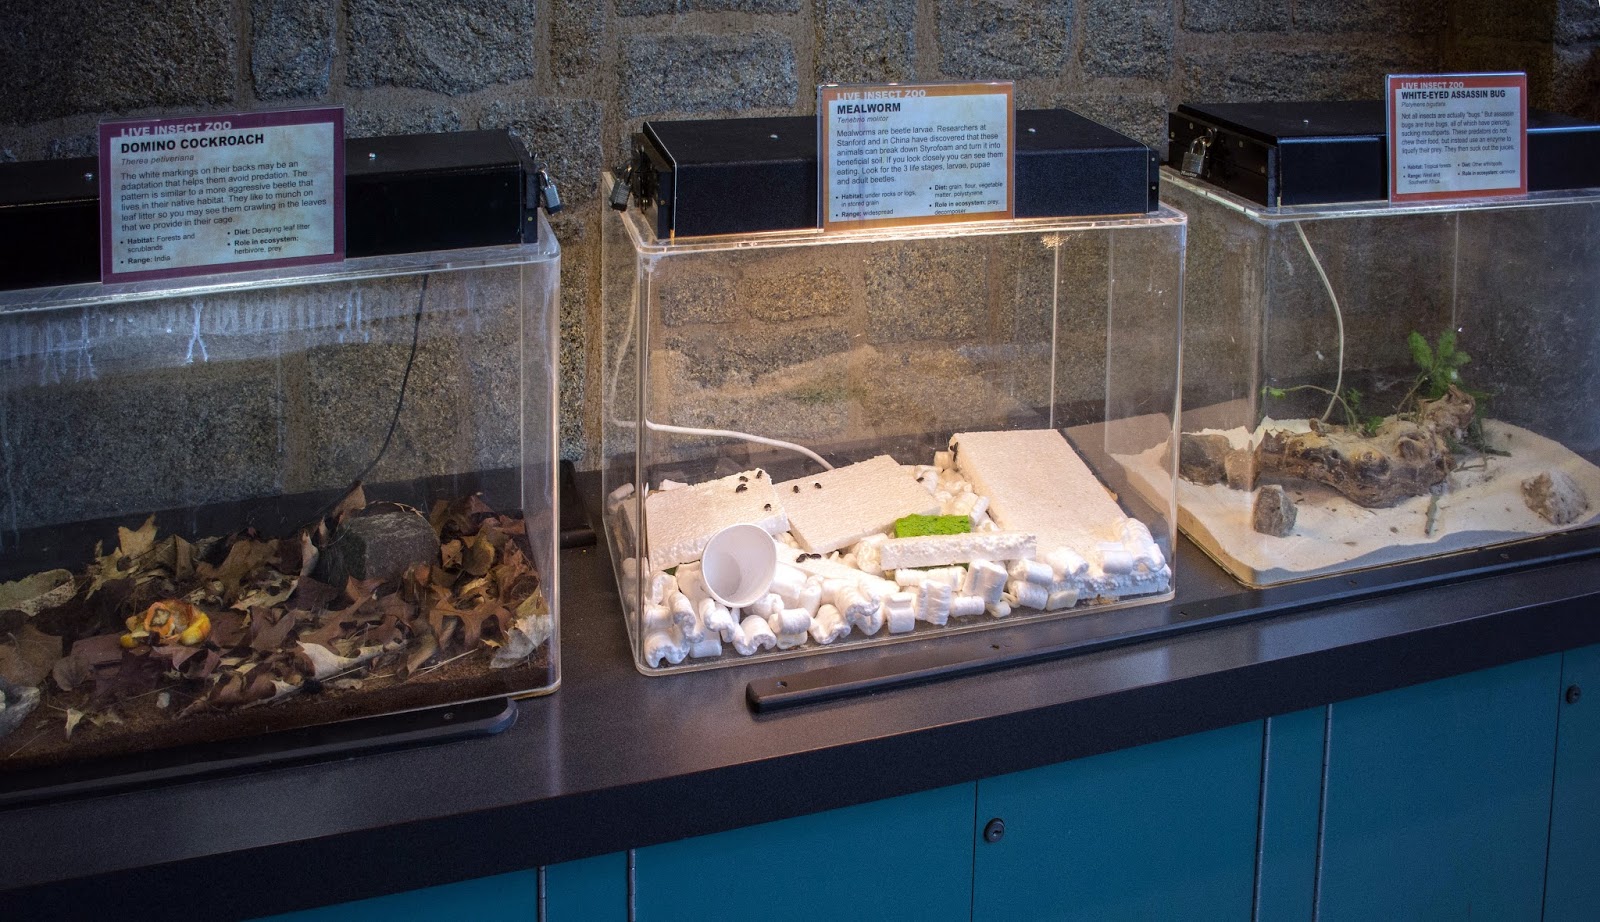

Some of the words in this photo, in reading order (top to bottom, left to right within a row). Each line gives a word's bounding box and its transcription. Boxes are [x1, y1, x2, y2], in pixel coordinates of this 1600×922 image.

[864, 91, 902, 99] INSECT
[1402, 91, 1449, 99] WHITE-EYED
[1452, 90, 1488, 98] ASSASSIN
[837, 103, 900, 114] MEALWORM
[121, 128, 150, 137] LIVE
[155, 124, 202, 135] INSECT
[205, 122, 231, 131] ZOO
[121, 140, 176, 153] DOMINO
[181, 134, 264, 149] COCKROACH
[920, 145, 954, 153] Styrofoam
[162, 169, 199, 177] markings
[232, 164, 256, 172] backs
[121, 181, 163, 191] adaptation
[165, 179, 181, 187] that
[183, 178, 204, 186] helps
[228, 174, 249, 182] avoid
[121, 193, 149, 202] pattern
[229, 184, 271, 194] aggressive
[273, 181, 297, 189] beetle
[171, 199, 195, 207] native
[229, 195, 248, 203] They
[275, 190, 302, 199] munch
[122, 213, 137, 221] leaf
[139, 212, 155, 220] litter
[170, 211, 185, 219] you
[244, 203, 276, 211] crawling
[153, 220, 183, 231] provide
